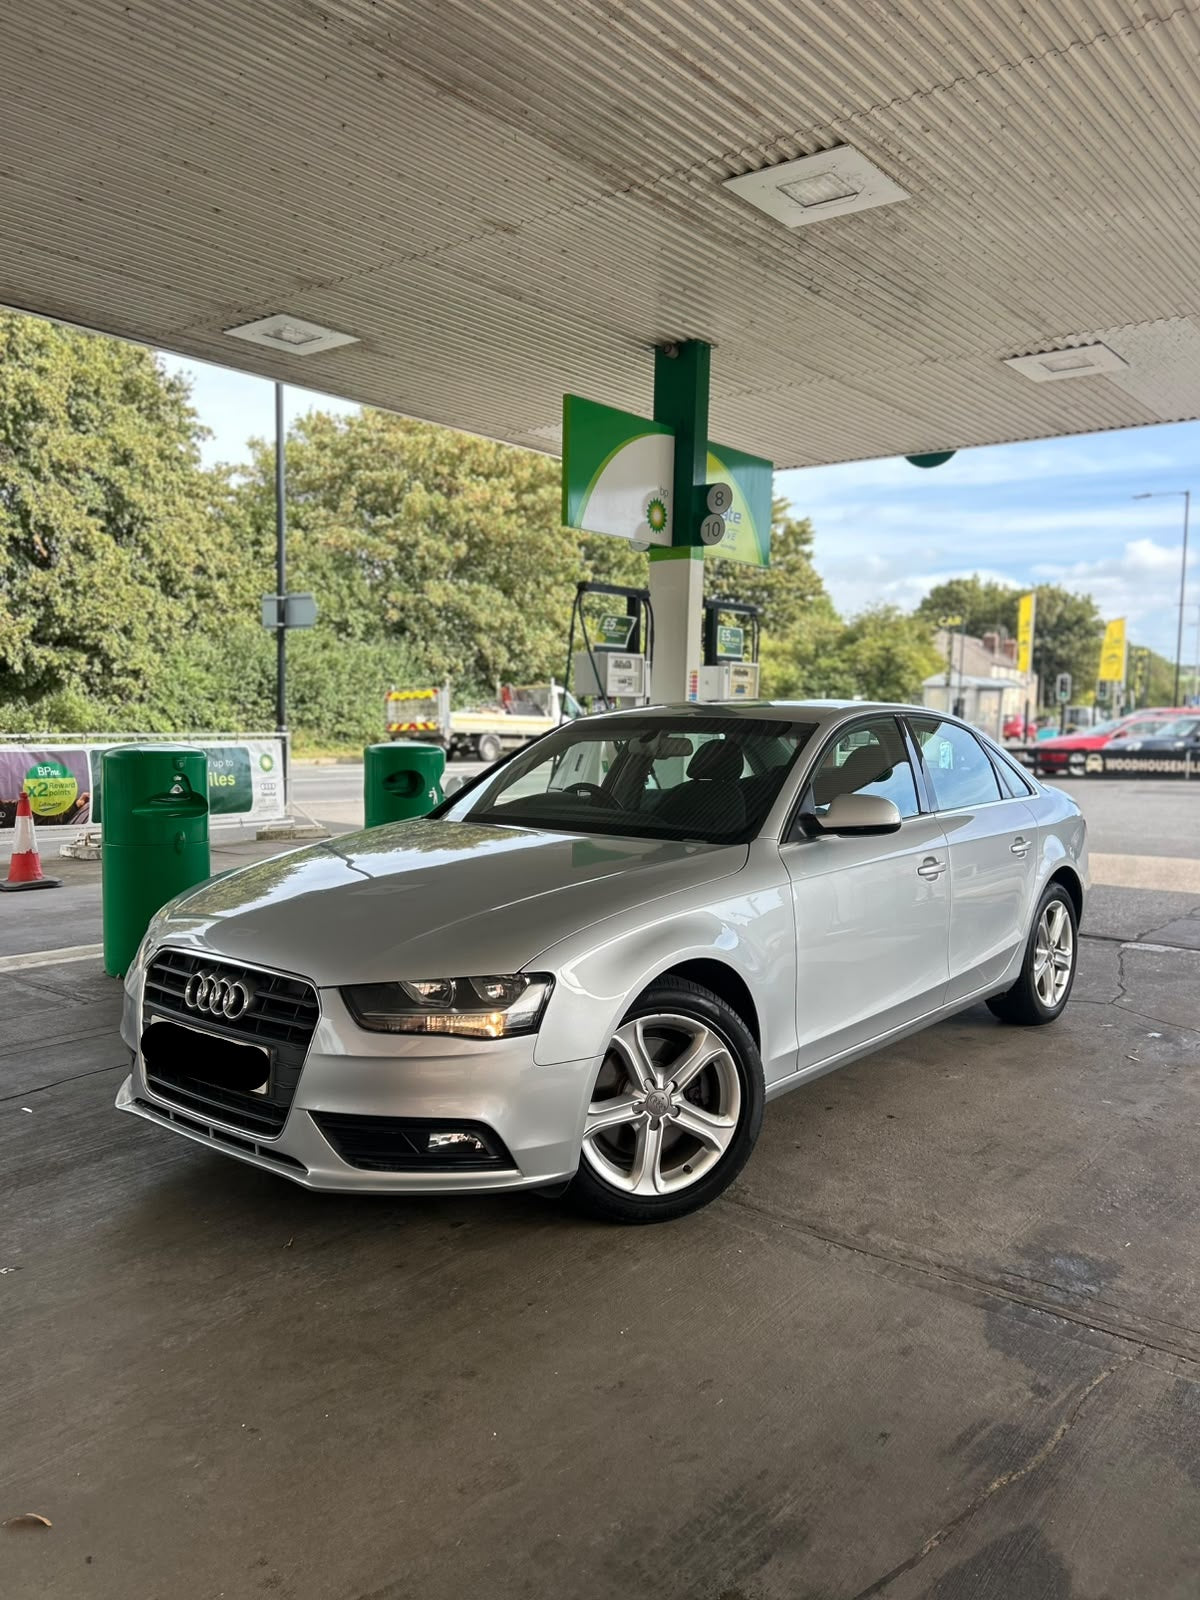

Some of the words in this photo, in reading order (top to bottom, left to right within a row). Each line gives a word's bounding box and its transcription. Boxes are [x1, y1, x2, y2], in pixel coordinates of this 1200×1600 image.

[660, 486, 669, 498] bp
[715, 491, 724, 506] 8
[705, 521, 721, 537] 10
[603, 617, 618, 630] £5
[938, 616, 962, 627] CAR
[721, 630, 731, 642] £5
[213, 760, 223, 768] up
[225, 759, 234, 767] to
[208, 773, 236, 787] iles
[27, 782, 48, 797] x2
